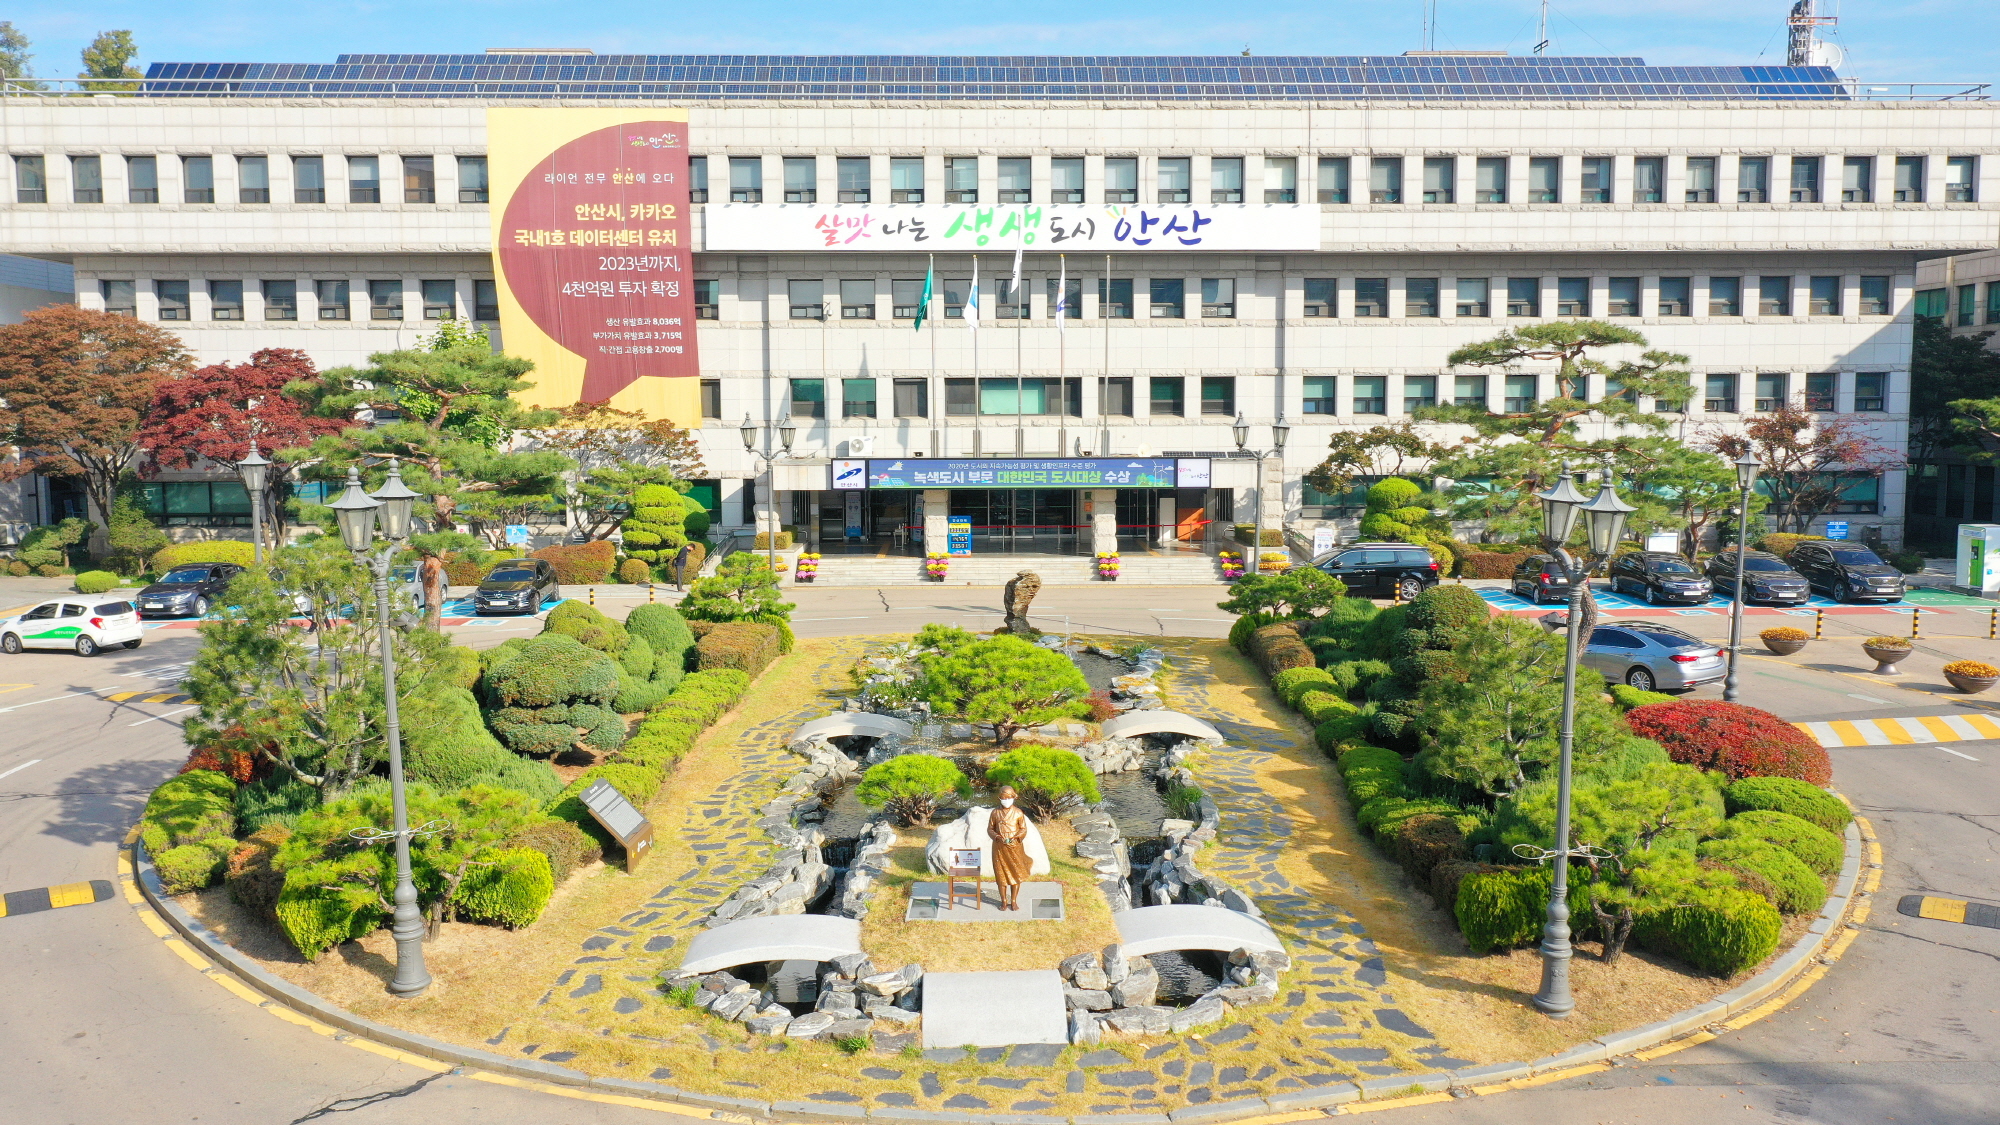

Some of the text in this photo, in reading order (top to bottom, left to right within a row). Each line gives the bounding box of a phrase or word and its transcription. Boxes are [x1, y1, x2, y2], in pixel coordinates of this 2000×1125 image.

[544, 172, 674, 184] 라이언 전무 안산에 오다
[574, 203, 677, 221] 안산시, 카카오
[1113, 209, 1212, 246] 안산
[514, 229, 677, 247] 국내1호 데이터센터 유치
[598, 255, 682, 272] 2023년까지,
[562, 280, 680, 298] 4천억원 투자 확정
[605, 318, 682, 327] 생산 유발효과 8,036억
[593, 332, 622, 340] 부가가치
[623, 332, 652, 340] 유발효과
[914, 471, 1130, 484] 녹색도시 부문 대한민국 도시대상 수상
